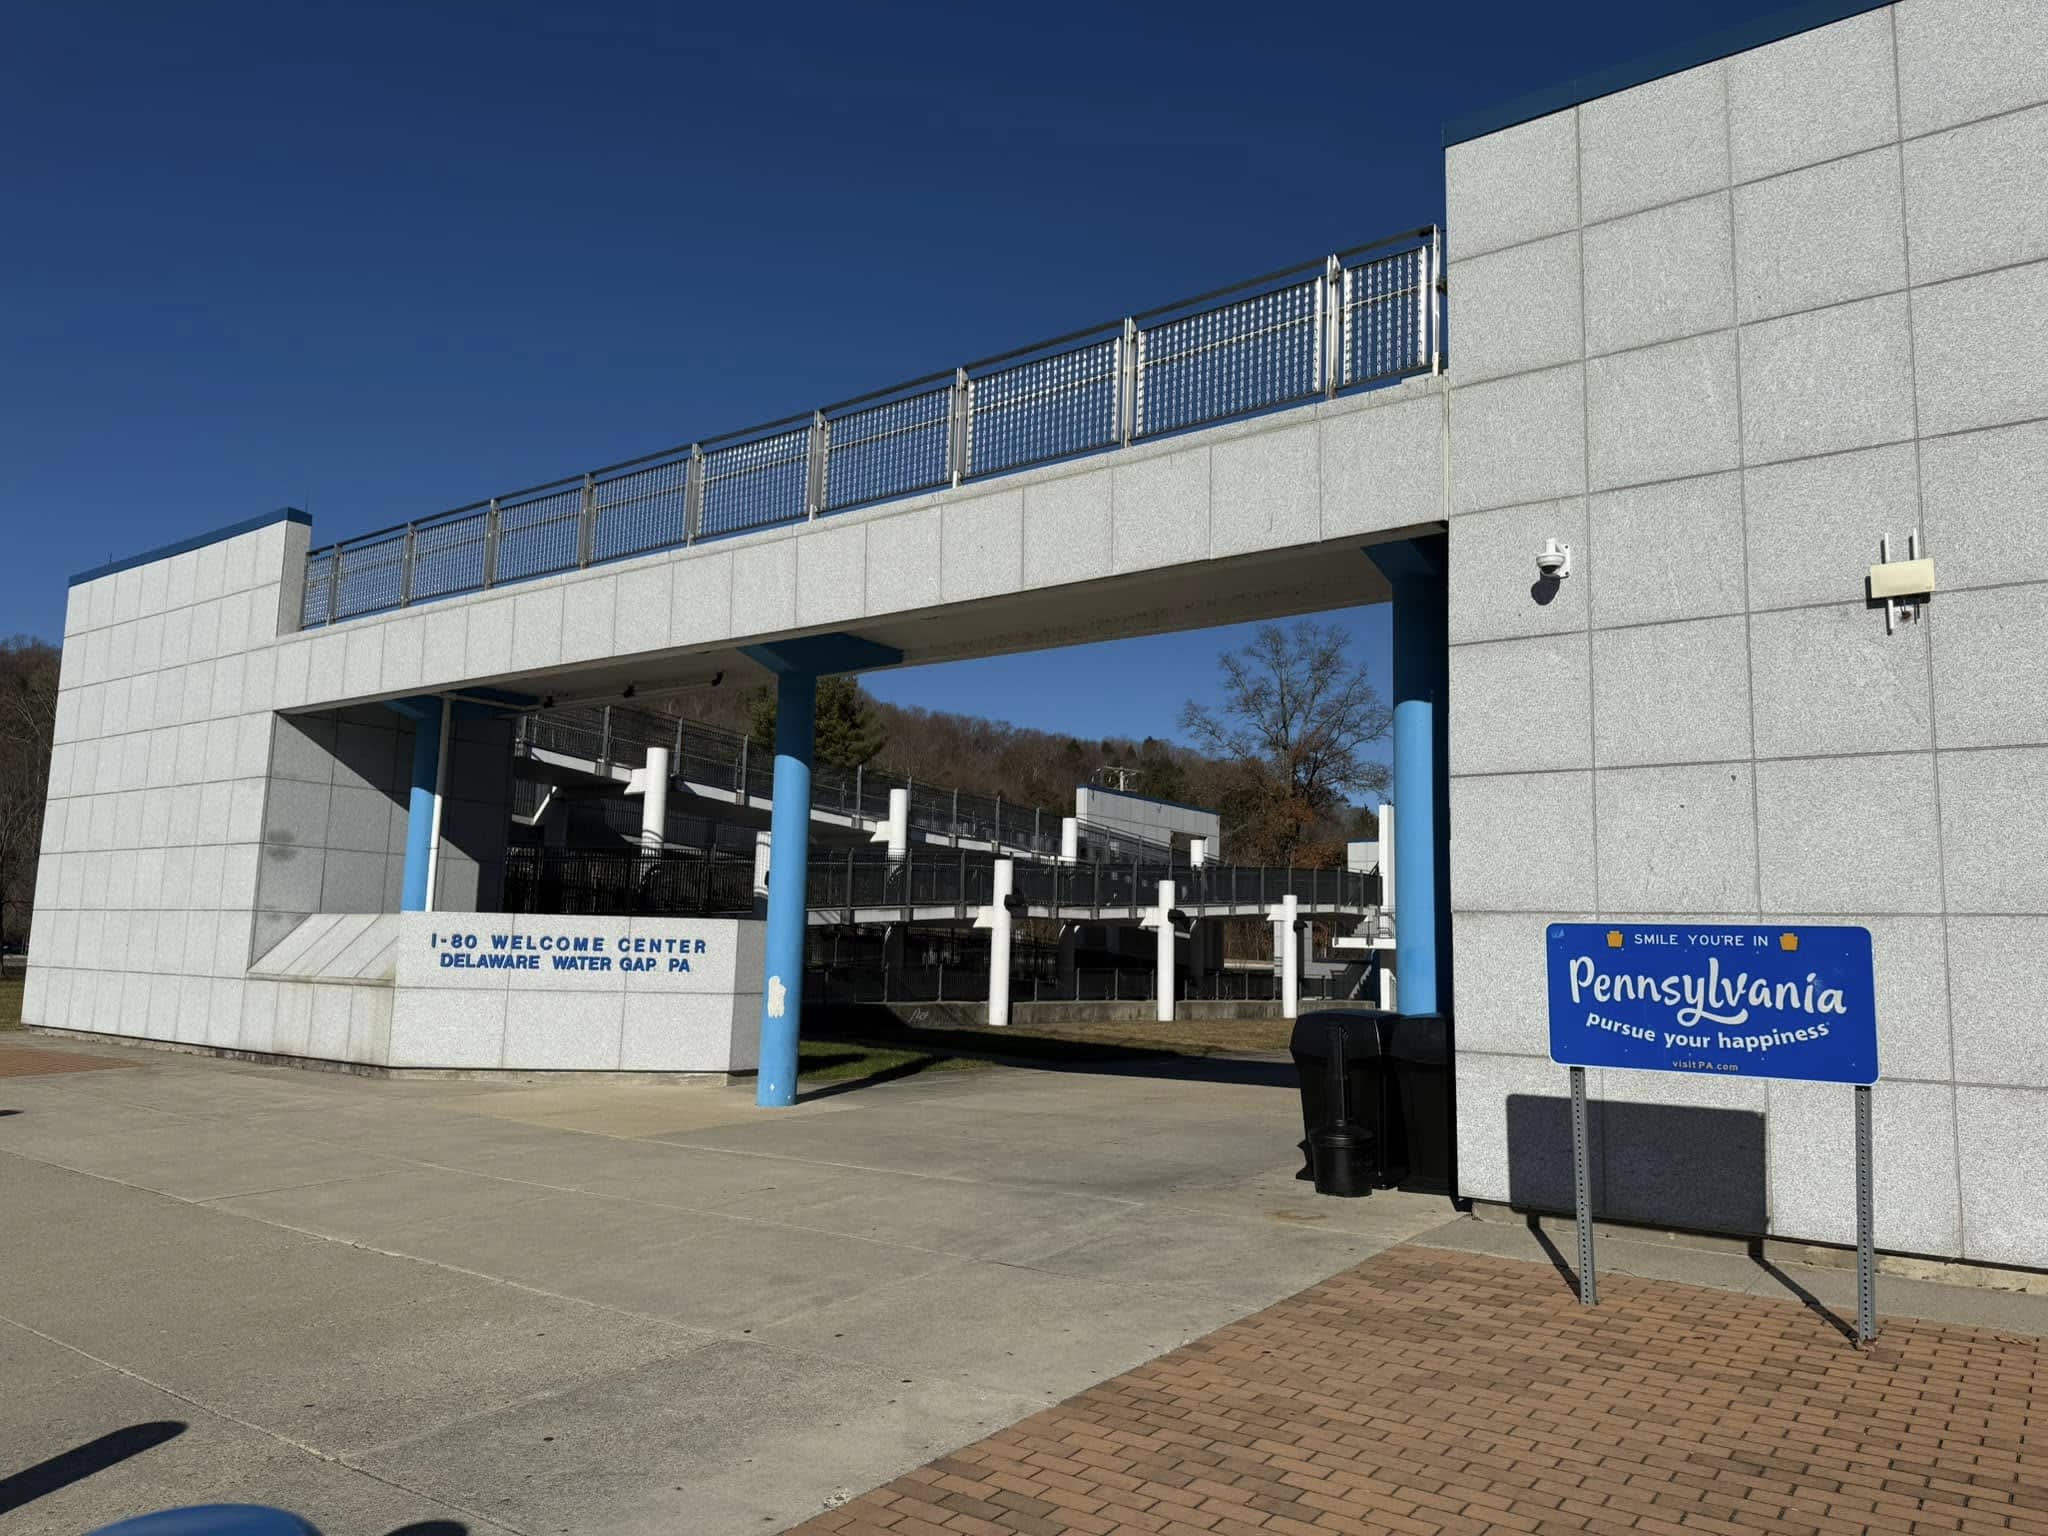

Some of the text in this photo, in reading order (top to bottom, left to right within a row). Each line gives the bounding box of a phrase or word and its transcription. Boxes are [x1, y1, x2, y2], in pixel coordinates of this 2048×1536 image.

[432, 934, 708, 954] I-80 WELCOME CENTER
[1634, 934, 1769, 947] SMILE YOU'RE IN
[440, 953, 691, 973] DELAWARE WATER GAP PA
[1569, 956, 1848, 1027] Pennsylvania
[1586, 1012, 1829, 1052] pursue your happiness
